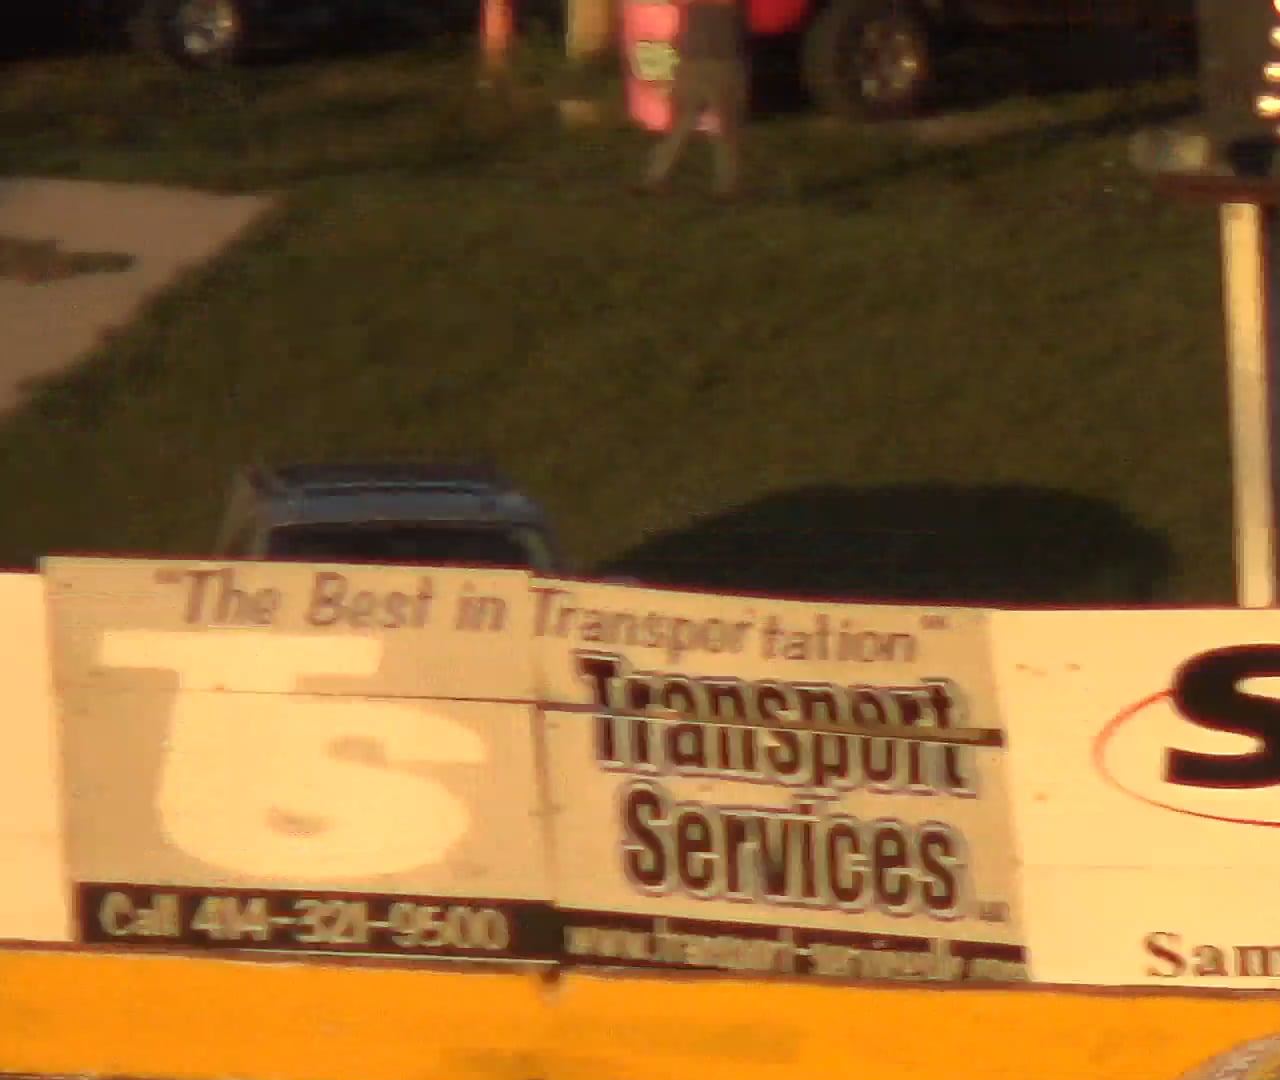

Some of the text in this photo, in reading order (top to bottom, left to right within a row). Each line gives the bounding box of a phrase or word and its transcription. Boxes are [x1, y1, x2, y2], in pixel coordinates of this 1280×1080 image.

[308, 573, 431, 629] Best
[456, 582, 508, 632] in
[575, 652, 983, 802] Transport
[621, 778, 967, 920] Services
[98, 890, 181, 938] Call
